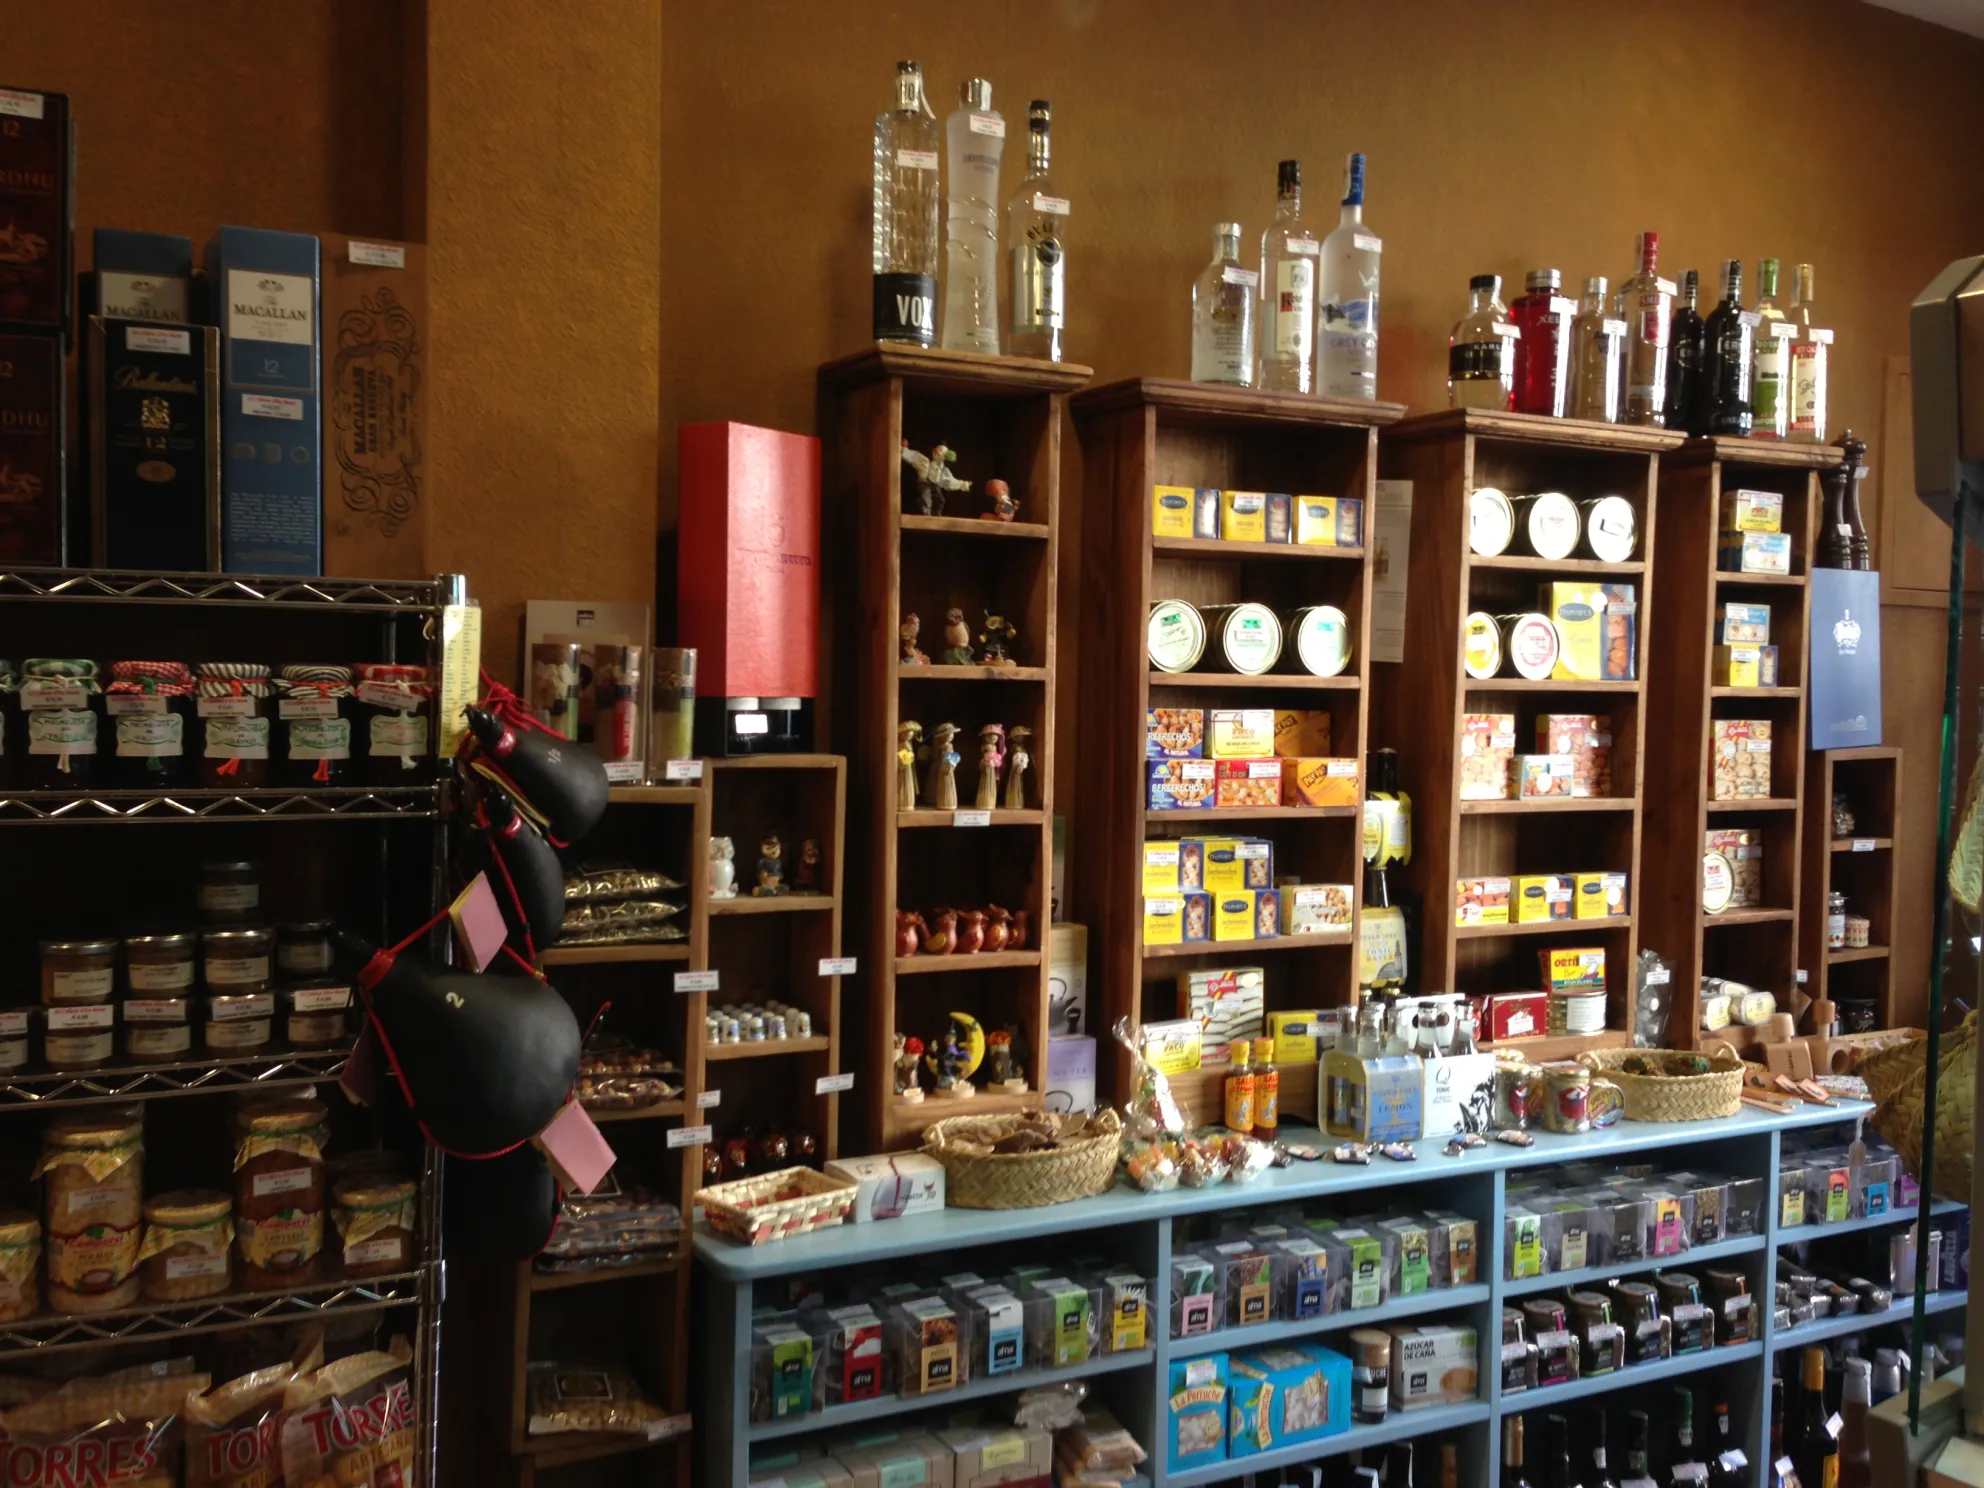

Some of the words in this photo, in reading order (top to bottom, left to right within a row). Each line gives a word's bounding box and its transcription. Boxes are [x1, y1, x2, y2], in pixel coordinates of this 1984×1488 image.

[233, 303, 309, 321] MACALLAN
[896, 294, 934, 330] VOX
[1151, 783, 1205, 793] BERBERECHOS
[1187, 1389, 1221, 1402] Perruche
